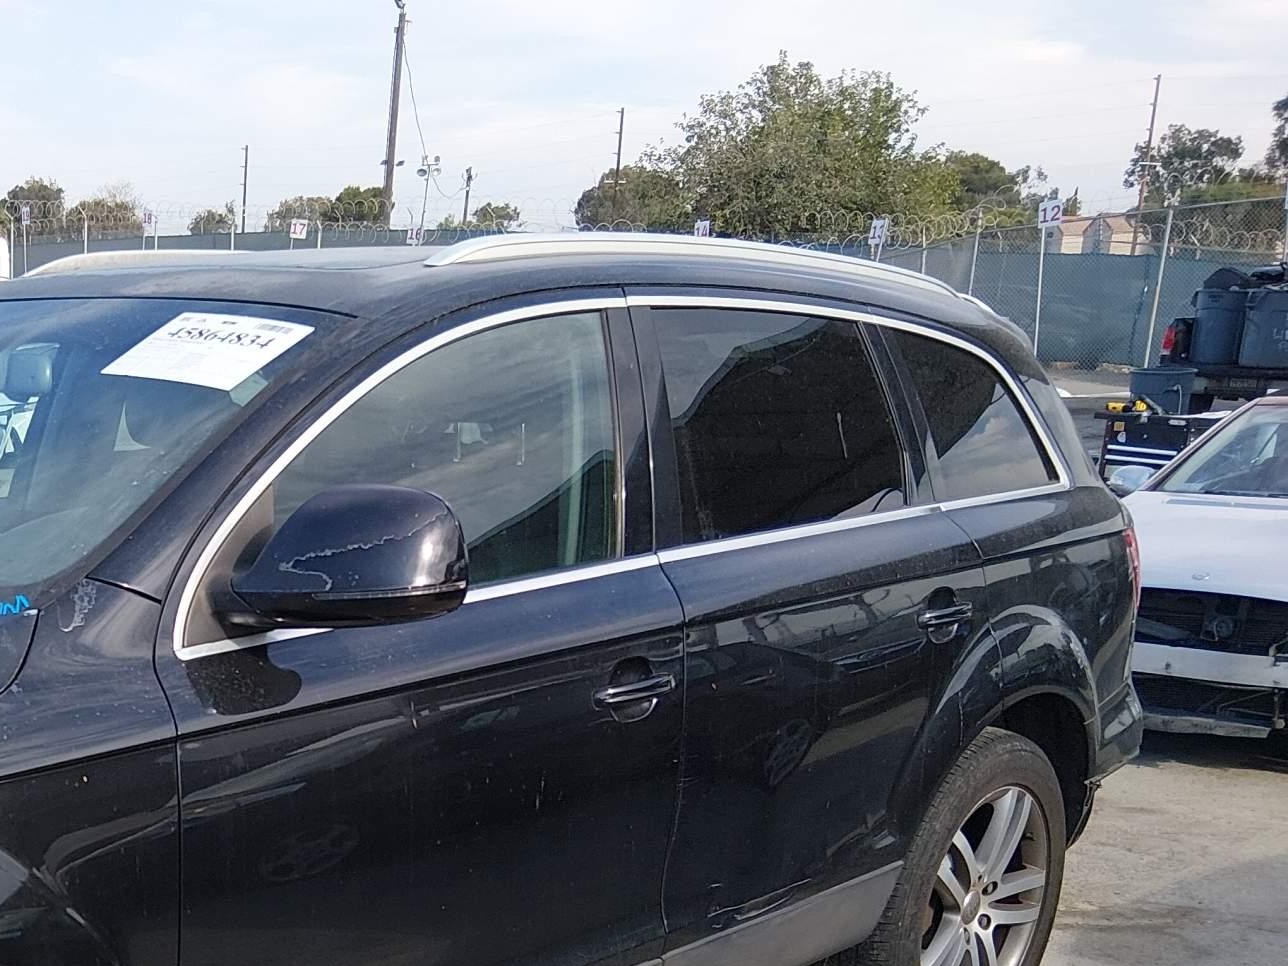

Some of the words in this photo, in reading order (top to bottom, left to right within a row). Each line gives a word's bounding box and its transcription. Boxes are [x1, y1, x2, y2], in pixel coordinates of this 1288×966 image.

[143, 212, 152, 225] 18
[1040, 204, 1061, 224] 12
[291, 223, 306, 235] 17
[407, 227, 421, 241] 16
[167, 326, 276, 349] 45864834
